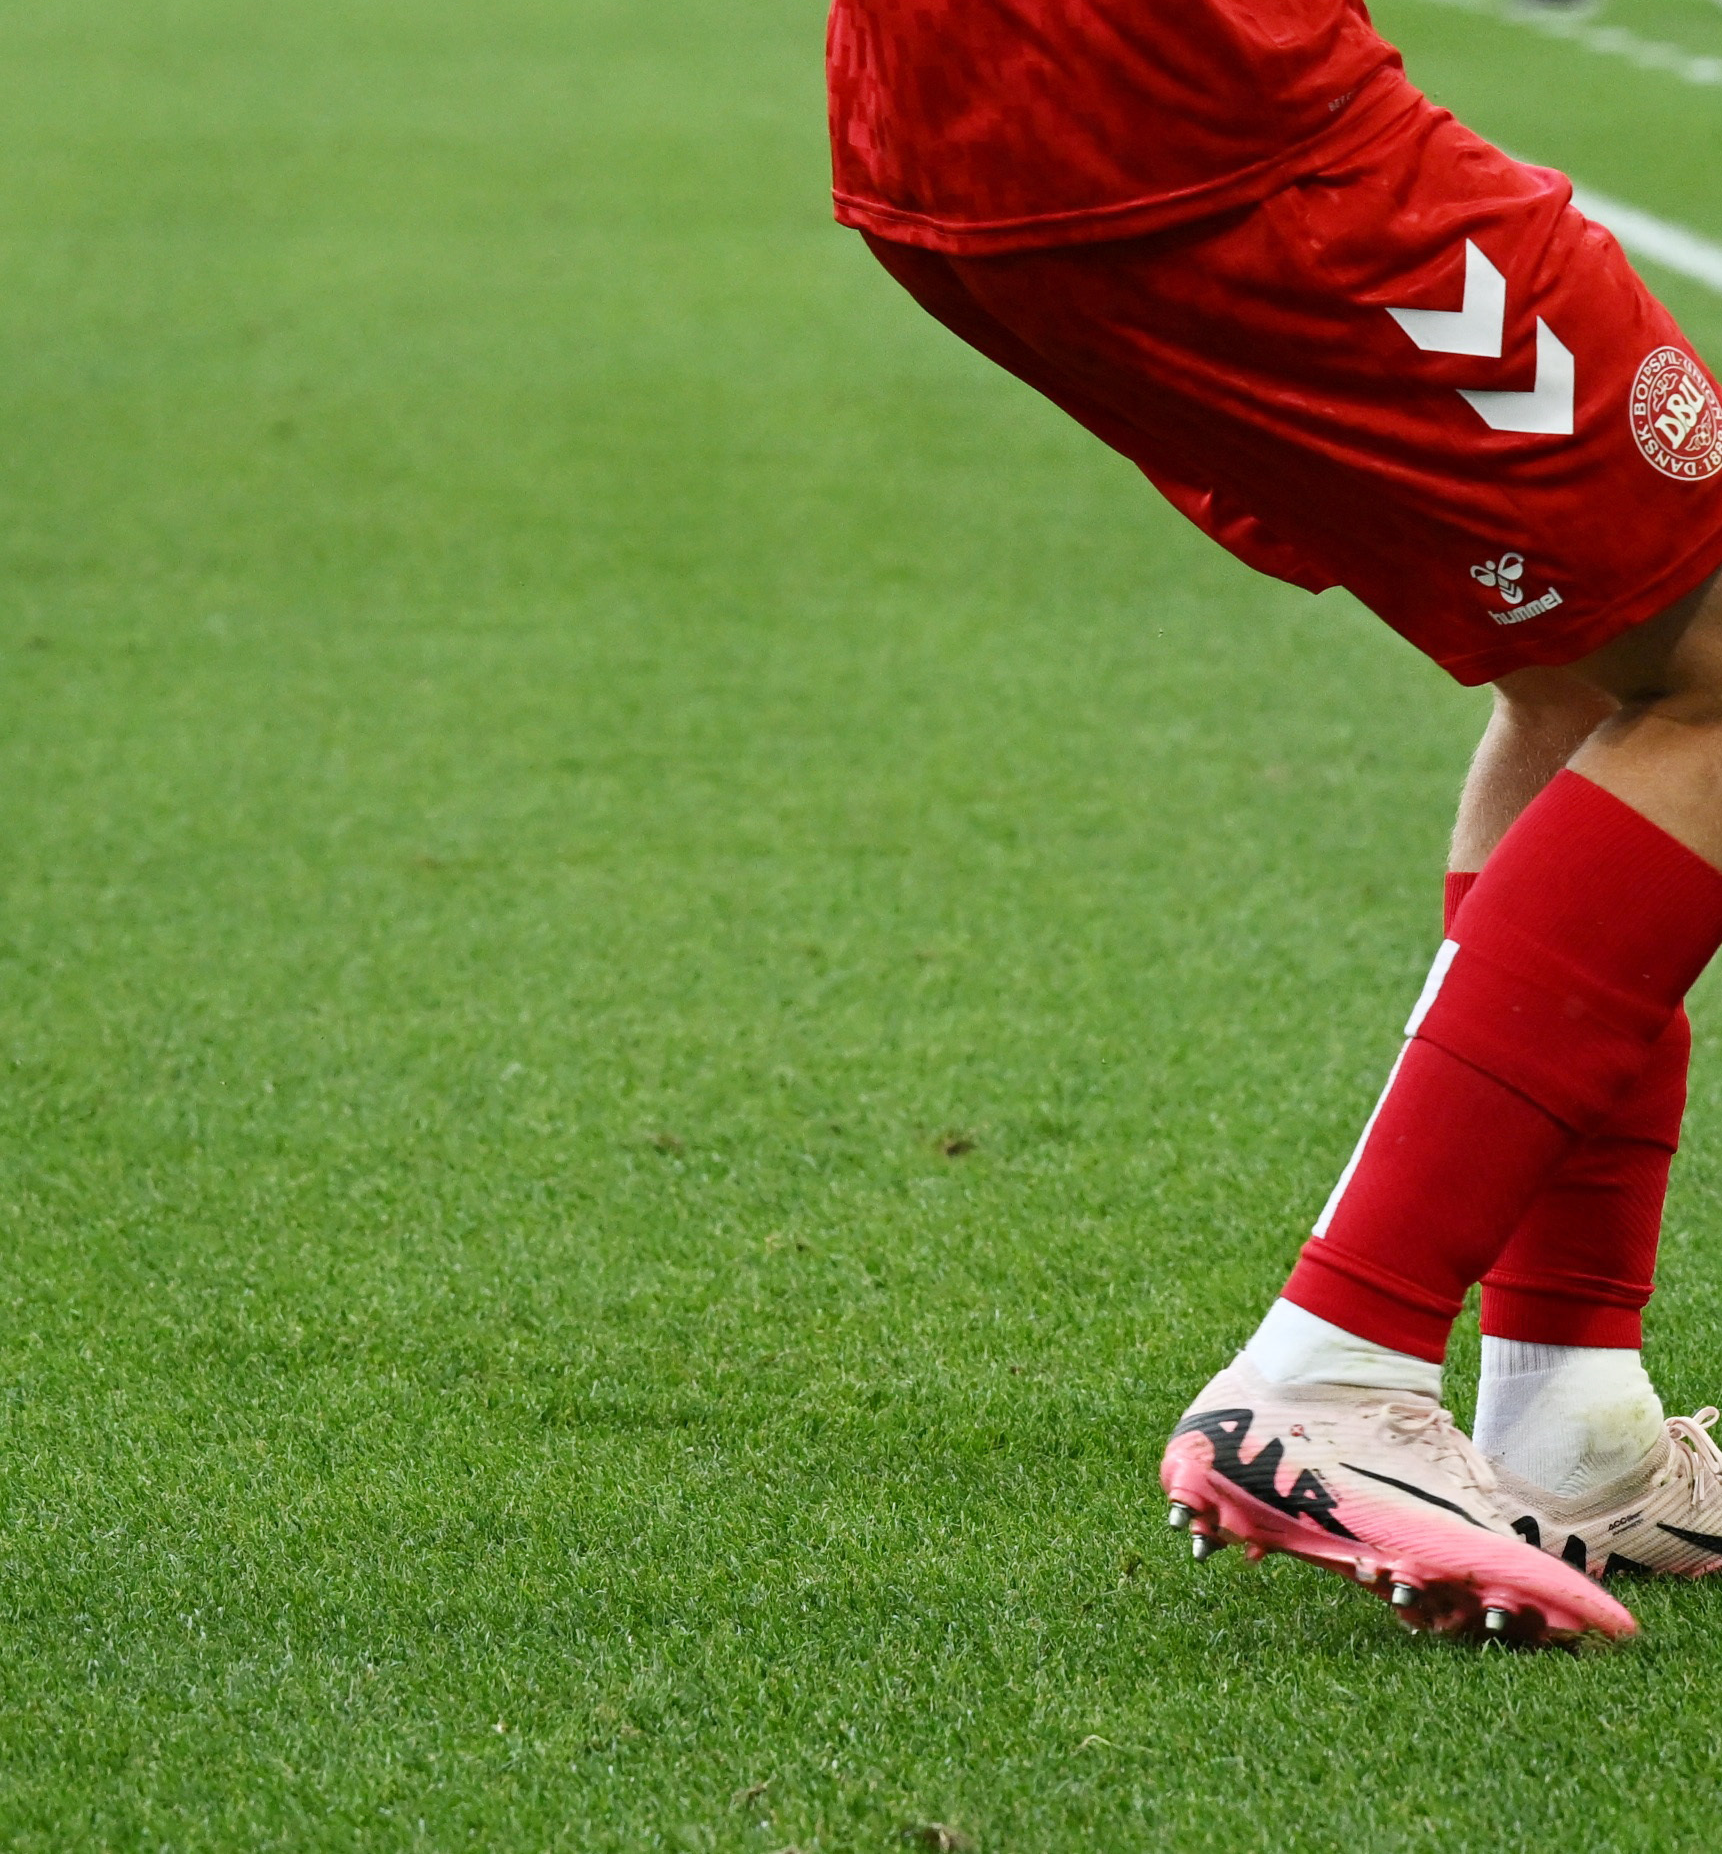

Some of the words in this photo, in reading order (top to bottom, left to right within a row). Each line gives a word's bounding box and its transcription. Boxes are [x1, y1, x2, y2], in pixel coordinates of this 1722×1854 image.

[1655, 374, 1705, 450] DBU
[1637, 424, 1696, 475] DANSK
[1487, 586, 1563, 625] hummel
